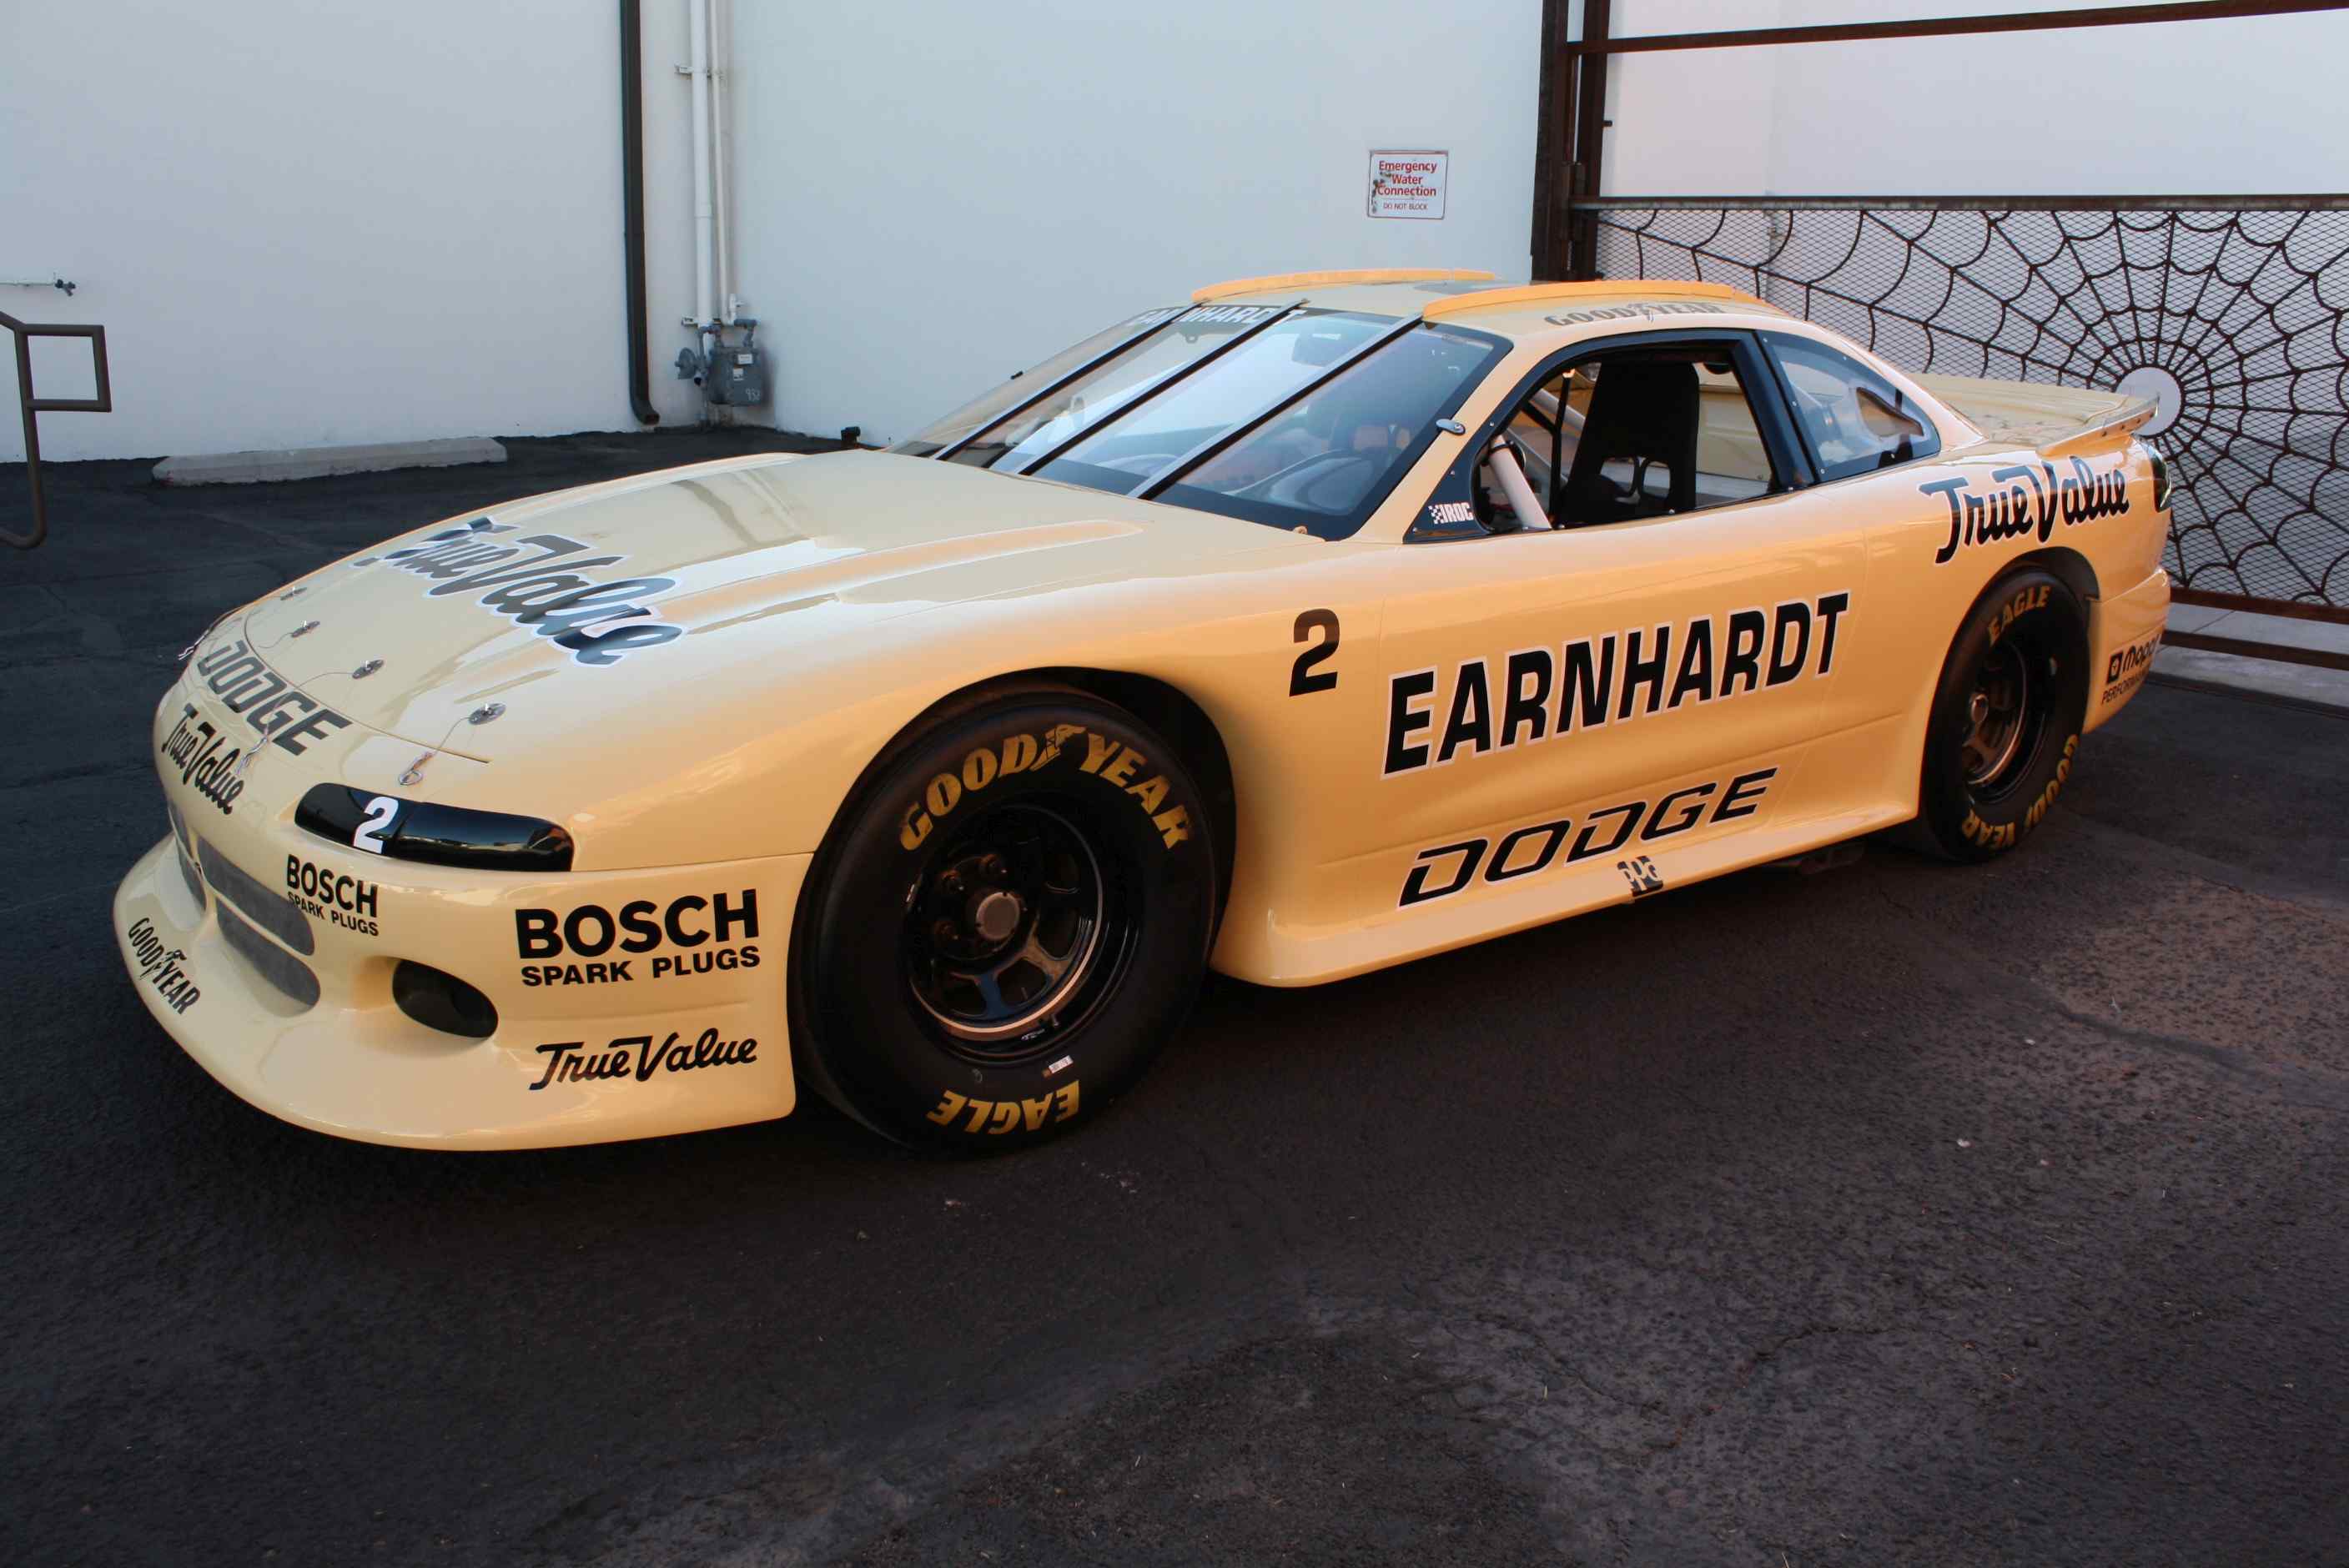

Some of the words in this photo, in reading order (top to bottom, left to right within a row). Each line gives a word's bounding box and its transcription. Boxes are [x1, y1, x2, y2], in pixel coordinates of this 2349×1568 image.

[1377, 185, 1436, 197] Connection
[1379, 160, 1437, 173] Emergency
[1391, 173, 1423, 184] Water
[1988, 585, 2051, 647] EAGLE
[1289, 607, 1340, 697] 2
[197, 639, 354, 756] DODGE
[1381, 591, 1850, 777] EARNHARDT
[353, 796, 400, 854] 2
[1398, 766, 1780, 908] DODGE
[286, 853, 378, 918] BOSCH
[287, 891, 326, 920] SPARK
[330, 908, 380, 937] PLUGS
[515, 888, 759, 959] BOSCH
[521, 960, 634, 987] SPARK
[651, 945, 761, 978] PLUGS
[927, 1080, 1079, 1134] EAGLE
